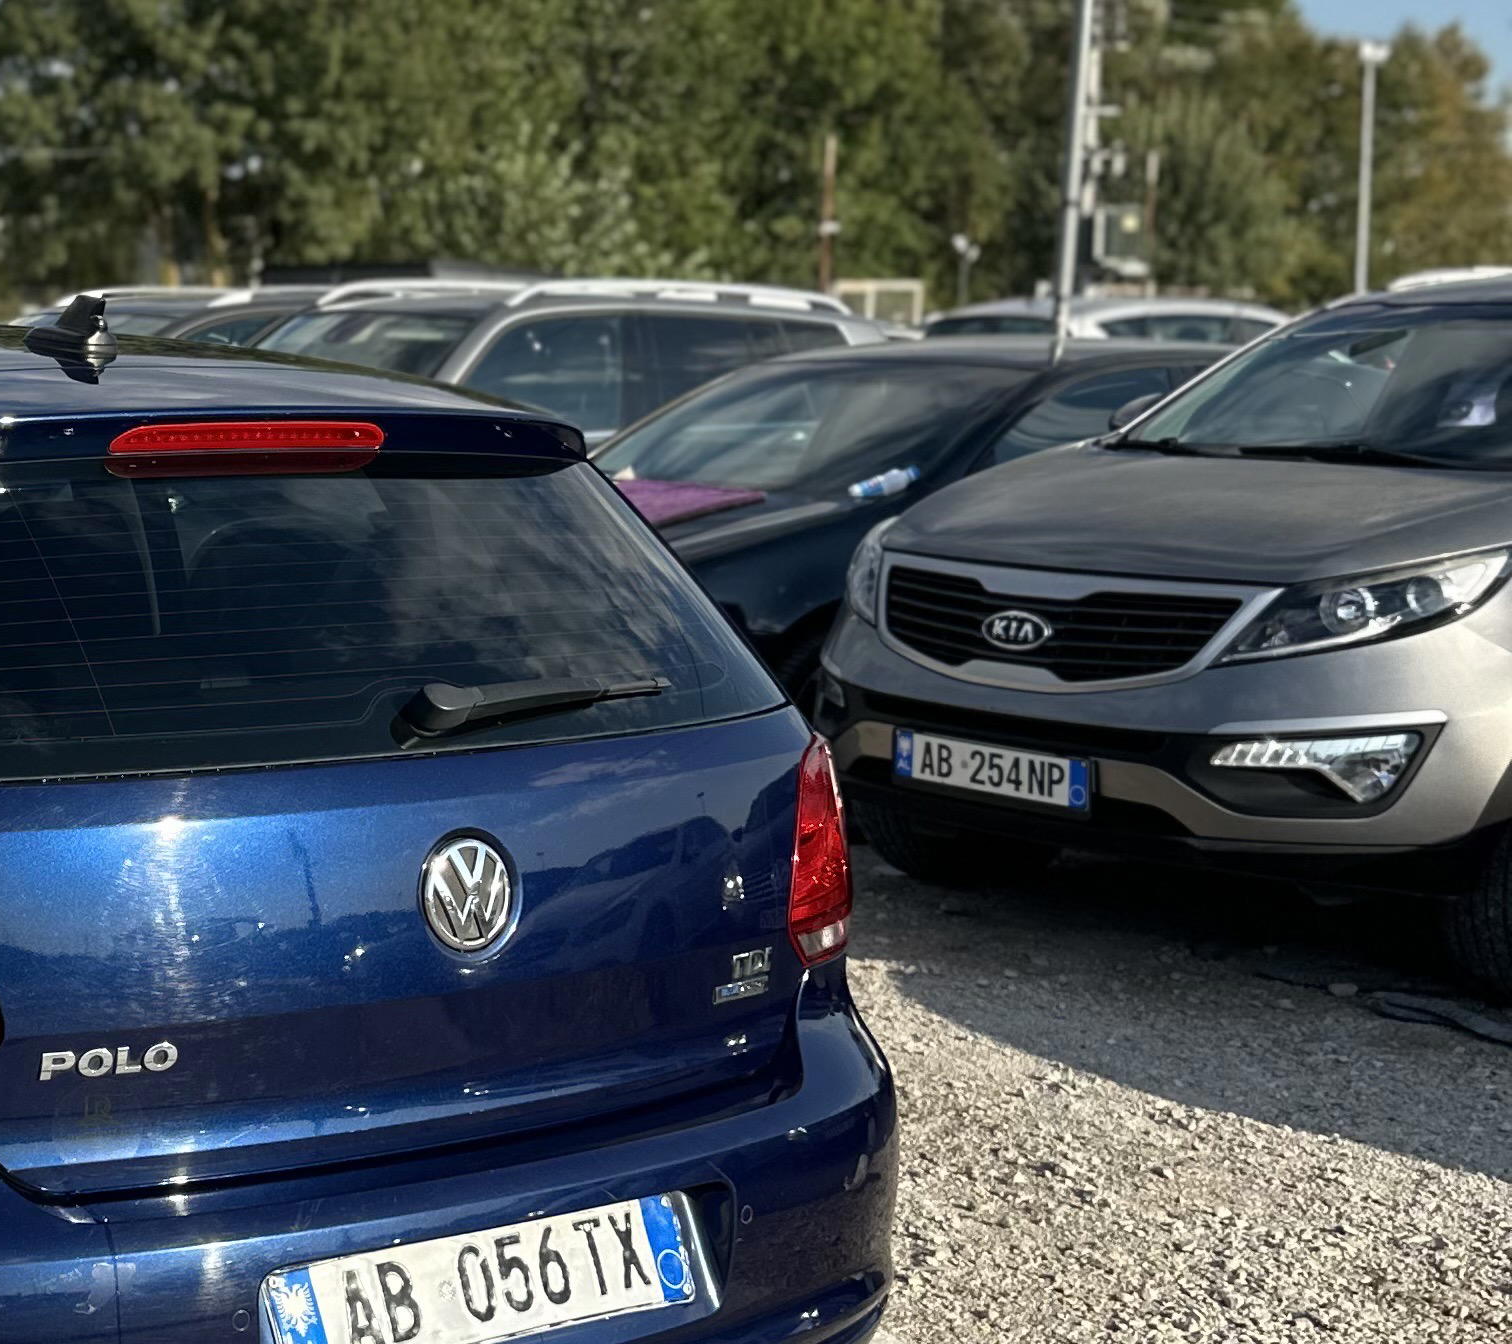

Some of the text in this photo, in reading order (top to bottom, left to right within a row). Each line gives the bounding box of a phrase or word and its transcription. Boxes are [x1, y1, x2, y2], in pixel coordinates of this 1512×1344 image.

[991, 618, 1034, 642] KIA
[920, 741, 953, 778] AB
[424, 839, 512, 950] VW
[39, 1040, 179, 1081] POLO
